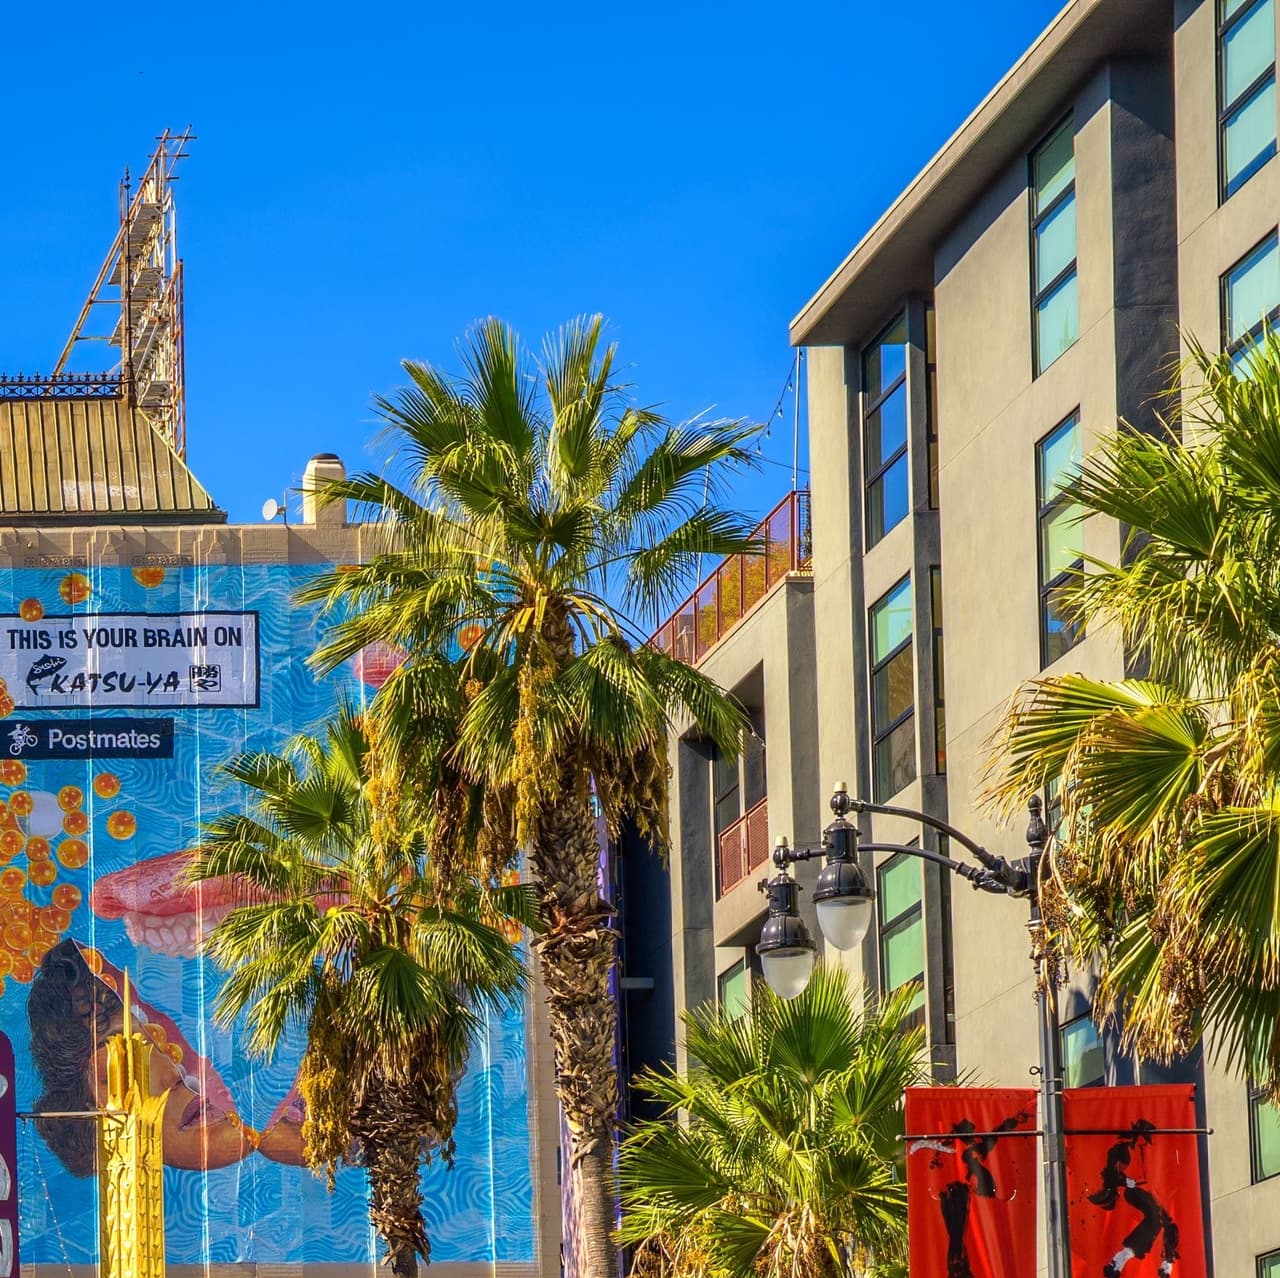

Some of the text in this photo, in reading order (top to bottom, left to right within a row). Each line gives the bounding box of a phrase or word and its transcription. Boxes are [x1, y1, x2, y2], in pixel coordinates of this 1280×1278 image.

[7, 626, 242, 650] THIS IS YOUR BRAIN ON
[49, 670, 180, 696] KATSU-YA
[48, 727, 161, 750] Postmates
